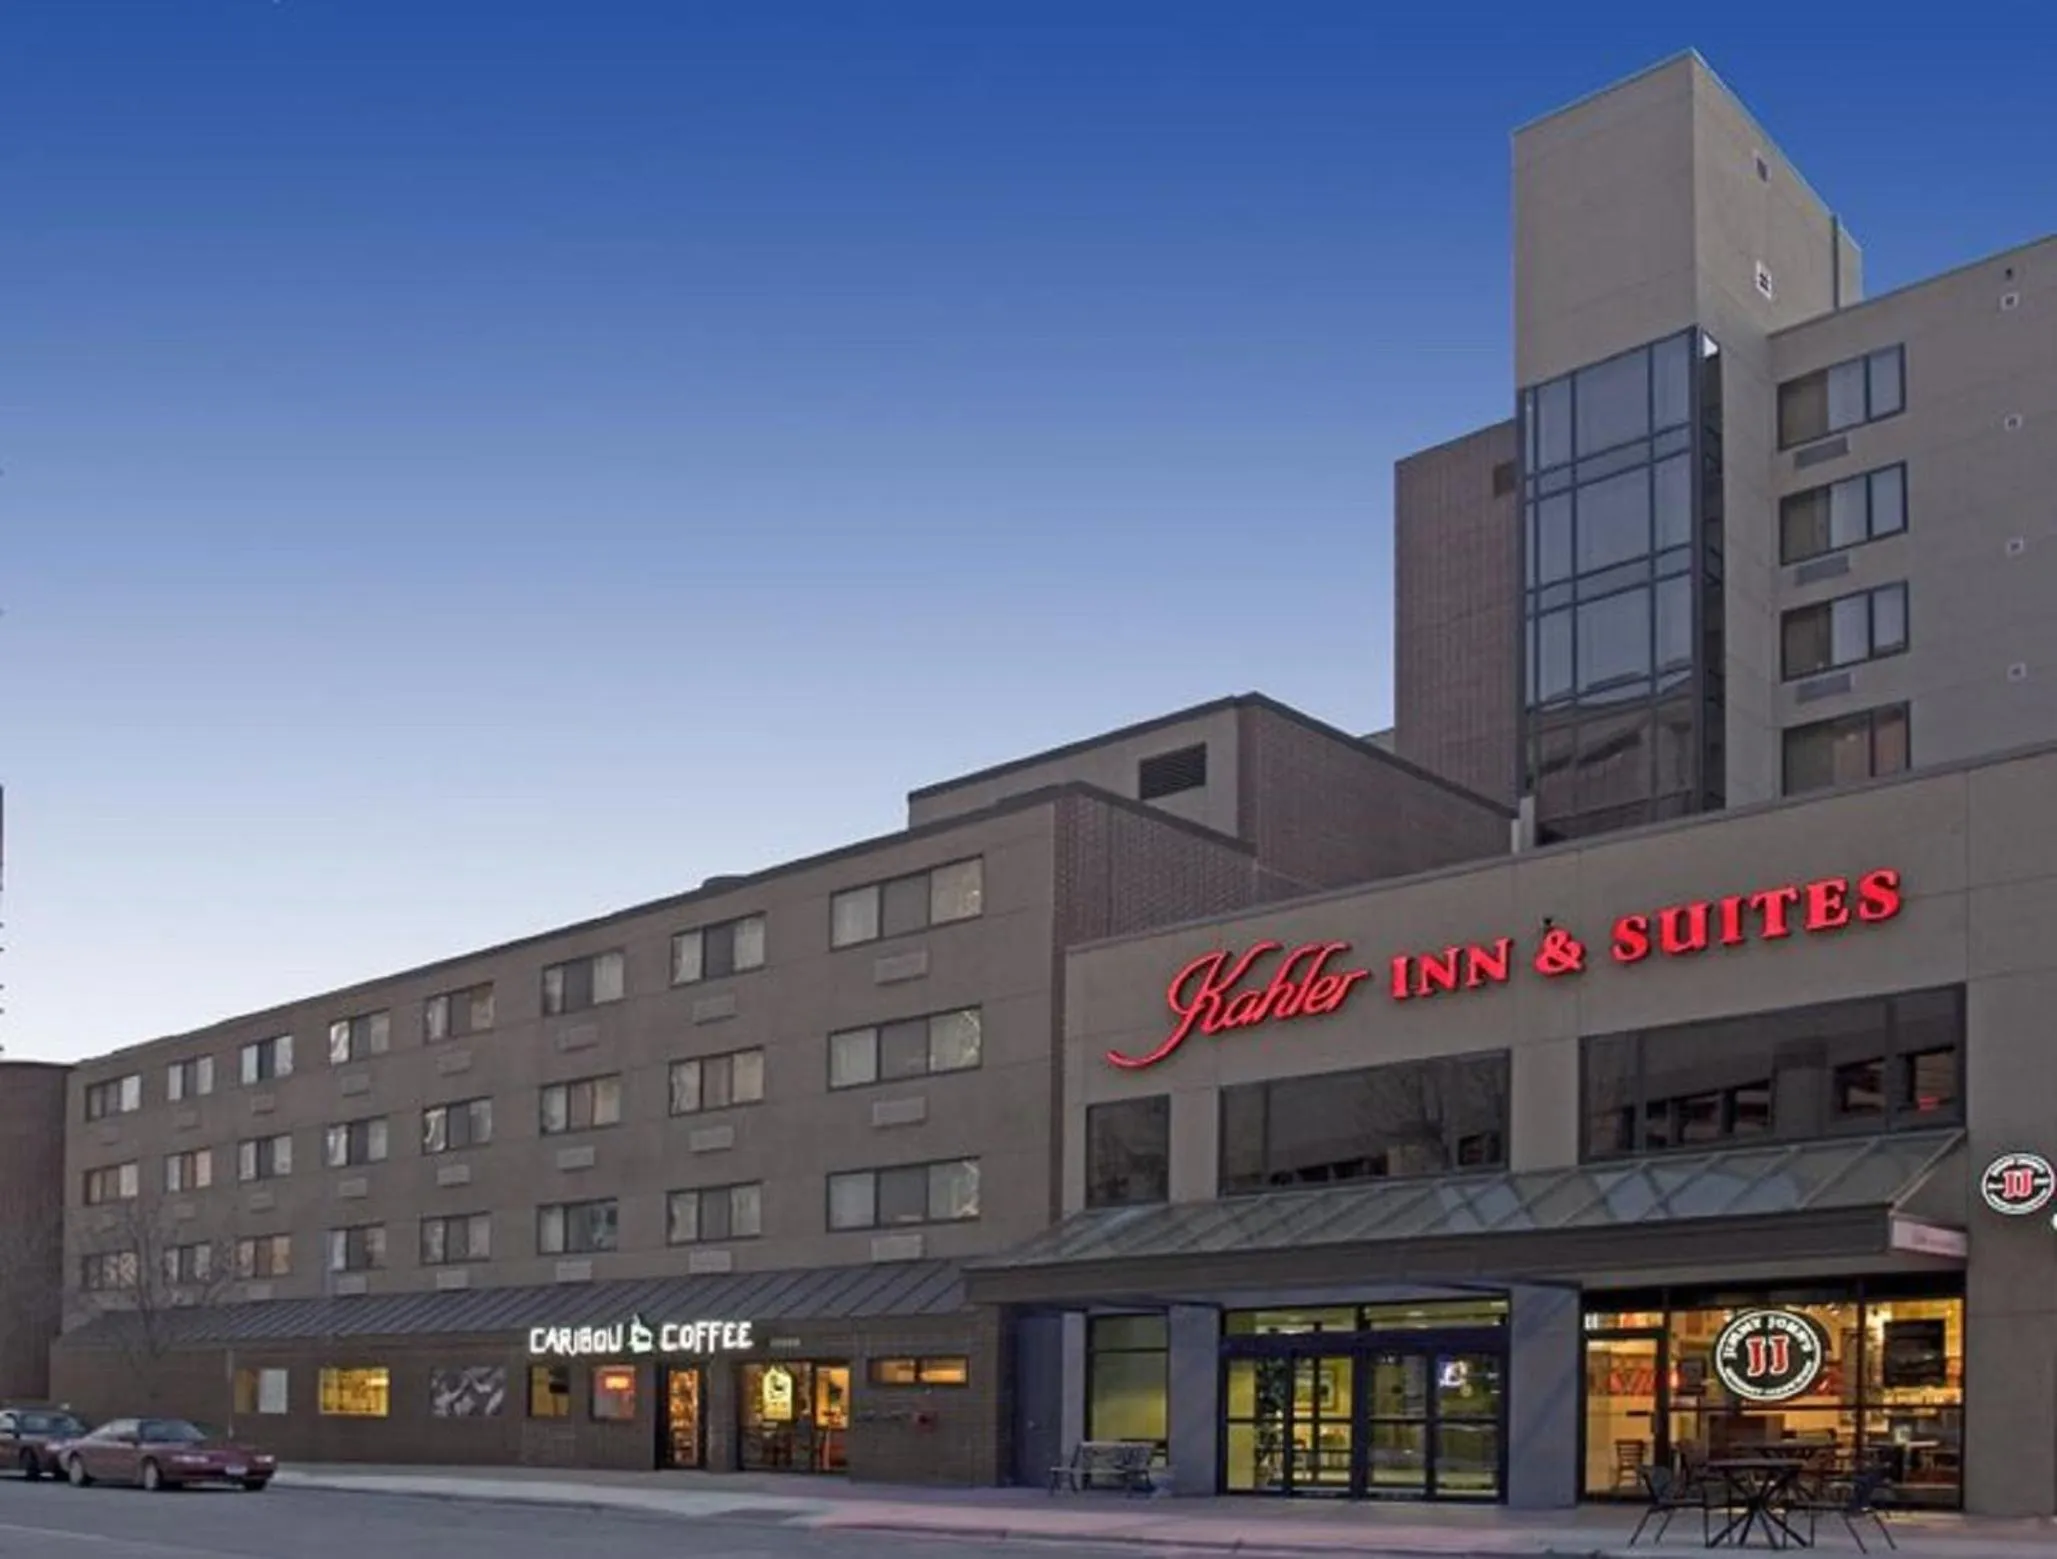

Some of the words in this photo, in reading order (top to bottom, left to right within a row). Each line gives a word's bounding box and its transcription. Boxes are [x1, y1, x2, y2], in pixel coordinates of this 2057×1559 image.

[1107, 940, 1369, 1067] Kahler
[1391, 937, 1510, 998] INN
[1534, 932, 1583, 975] &
[1611, 868, 1900, 961] SUITES
[530, 1323, 623, 1357] CARIBOU
[660, 1320, 754, 1353] COFFEE
